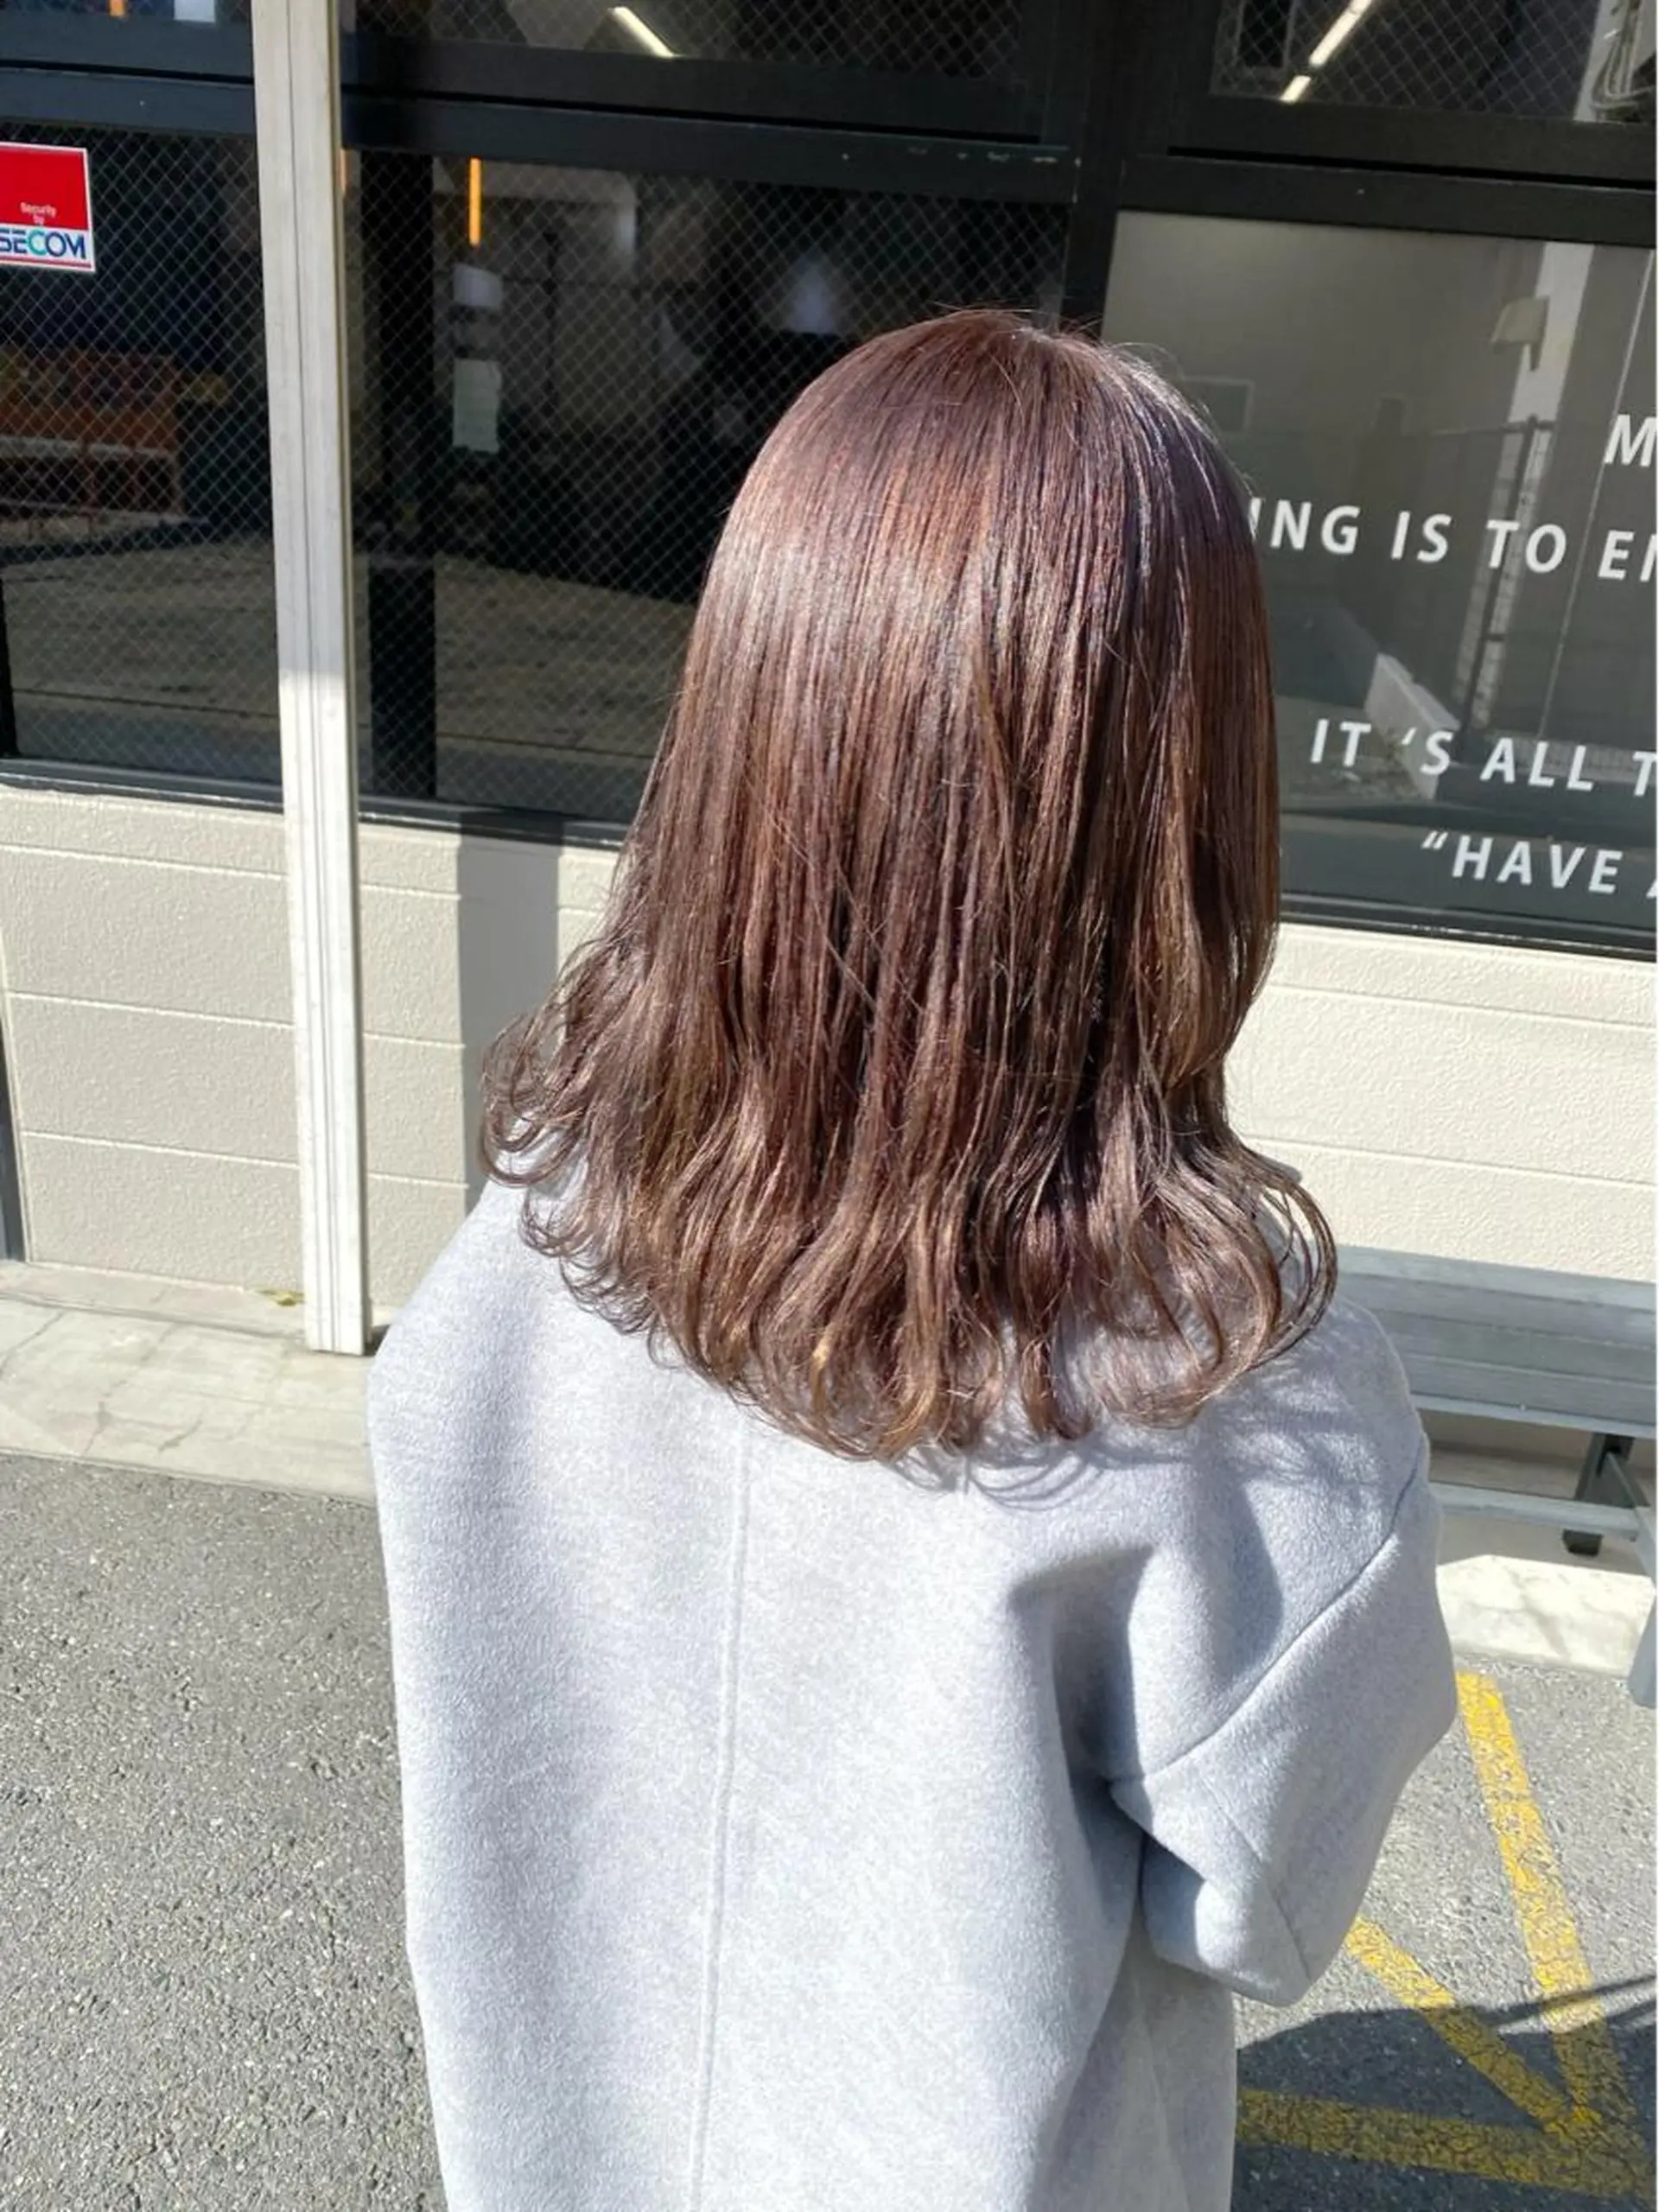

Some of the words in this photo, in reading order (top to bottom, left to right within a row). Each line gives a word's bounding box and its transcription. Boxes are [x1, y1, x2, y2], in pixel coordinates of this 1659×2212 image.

[0, 227, 86, 258] SECOM
[1390, 511, 1452, 563] IS
[1486, 519, 1567, 574] TO
[1310, 718, 1371, 767] IT
[1480, 737, 1594, 791] ALL
